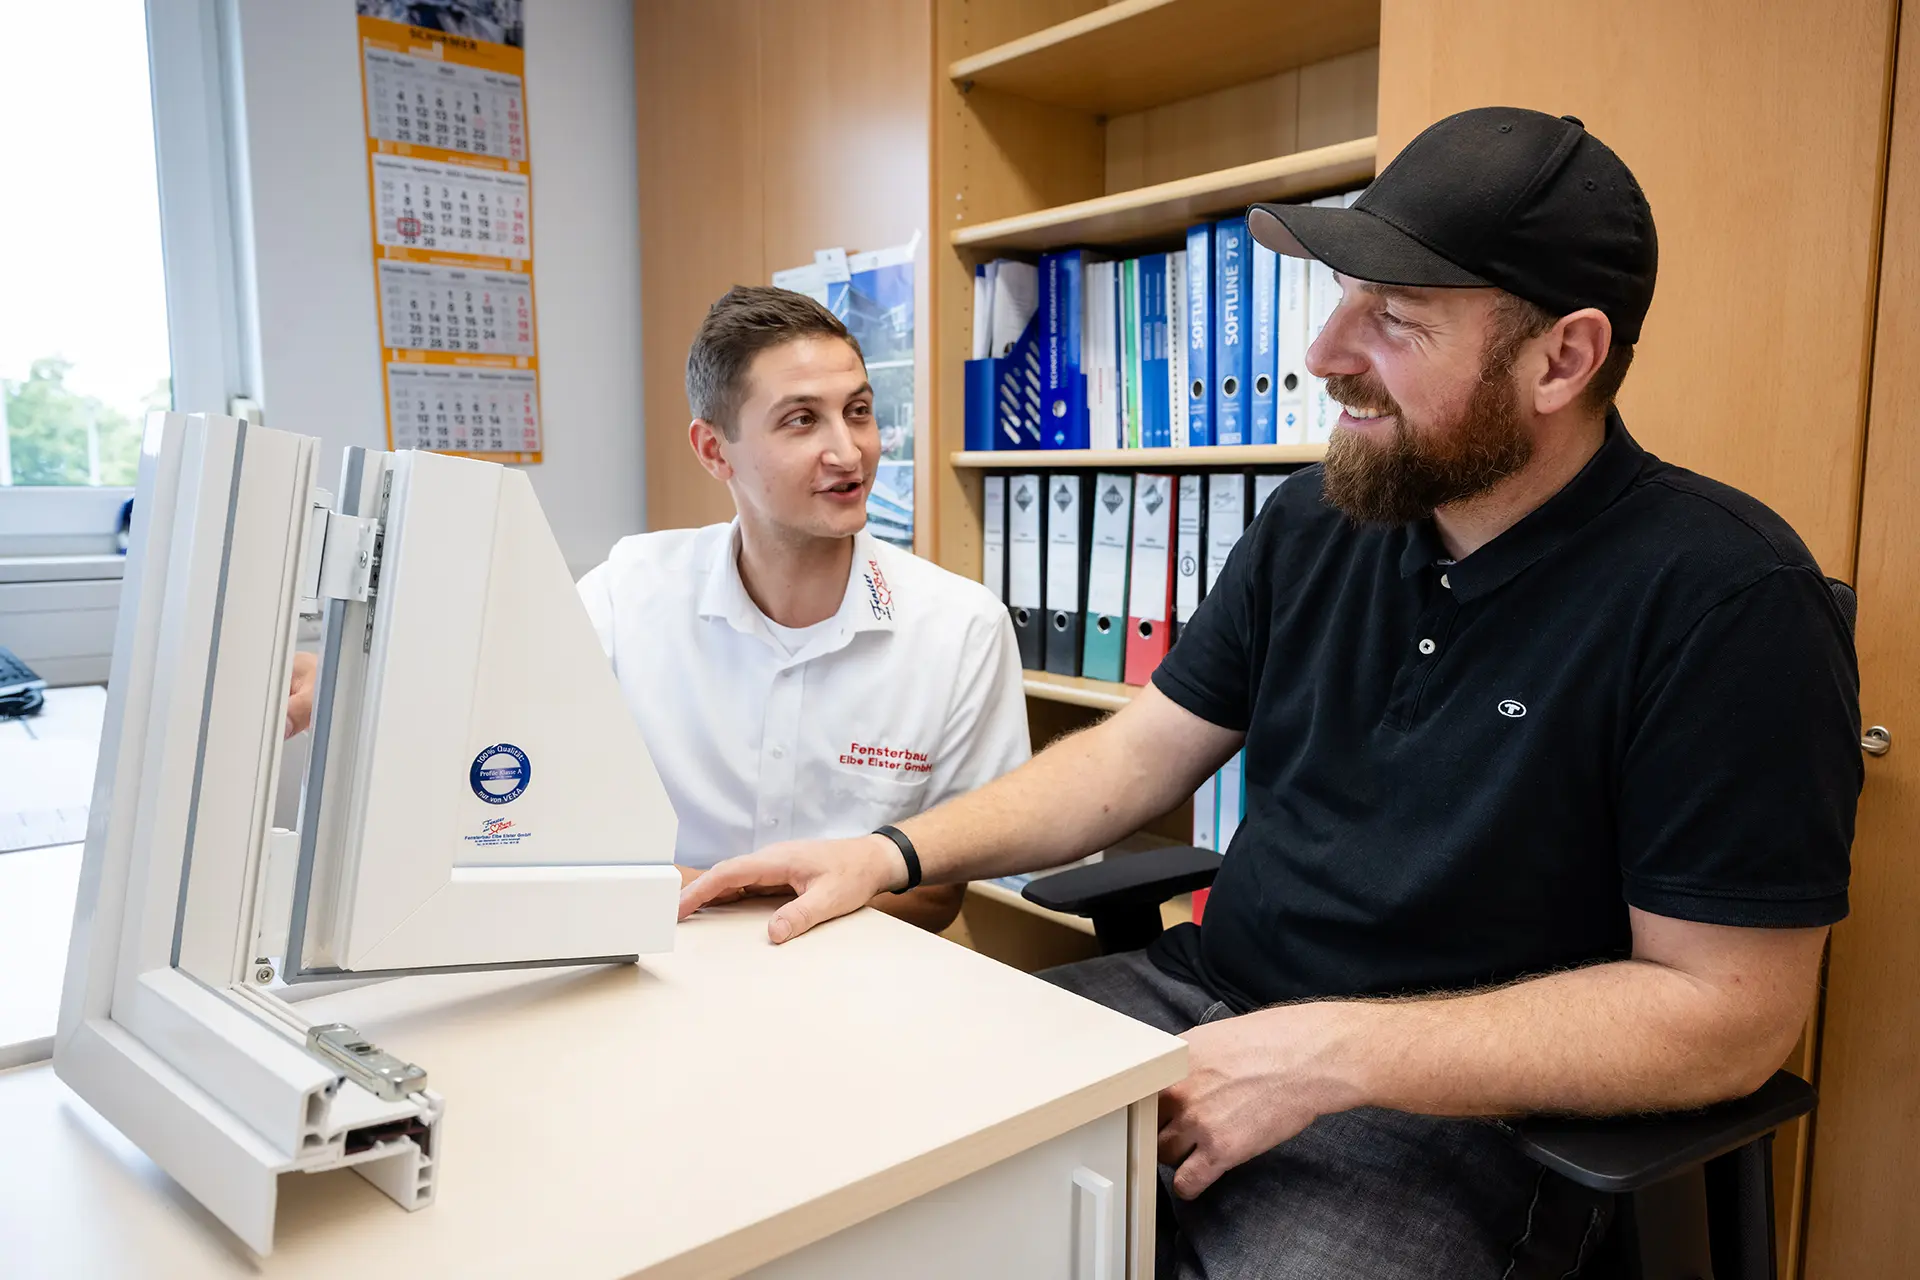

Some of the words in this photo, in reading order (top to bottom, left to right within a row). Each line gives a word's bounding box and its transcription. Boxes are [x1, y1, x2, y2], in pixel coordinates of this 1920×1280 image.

[396, 89, 405, 101] 4
[395, 102, 409, 114] 11
[415, 106, 428, 117] 12
[453, 112, 466, 124] 14
[396, 129, 410, 140] 25
[454, 125, 467, 136] 21
[403, 183, 410, 192] 1
[422, 185, 430, 195] 2
[442, 188, 449, 198] 3
[460, 190, 467, 200] 4
[478, 193, 485, 203] 5
[440, 200, 452, 210] 10
[459, 203, 471, 213] 11
[477, 205, 489, 215] 12
[440, 213, 452, 223] 17
[441, 226, 453, 236] 24
[1226, 236, 1238, 260] 76
[464, 291, 472, 301] 2
[1191, 269, 1204, 350] SOFTLINE
[1225, 264, 1238, 346] SOFTLINE
[408, 312, 422, 321] 13
[428, 313, 440, 323] 14
[482, 318, 495, 327] 17
[428, 326, 441, 335] 21
[410, 337, 423, 346] 27
[436, 402, 444, 410] 4
[489, 404, 497, 412] 7
[415, 413, 429, 422] 10
[435, 414, 447, 423] 11
[453, 414, 466, 423] 12
[471, 415, 483, 424] 13
[488, 416, 501, 425] 14
[416, 425, 430, 434] 17
[476, 748, 496, 764] 100%
[851, 742, 928, 762] Fensterbau
[840, 755, 863, 765] Elbe
[868, 757, 901, 770] Elster
[904, 761, 932, 773] GmbH
[478, 790, 490, 800] nur
[502, 788, 522, 802] VEKA
